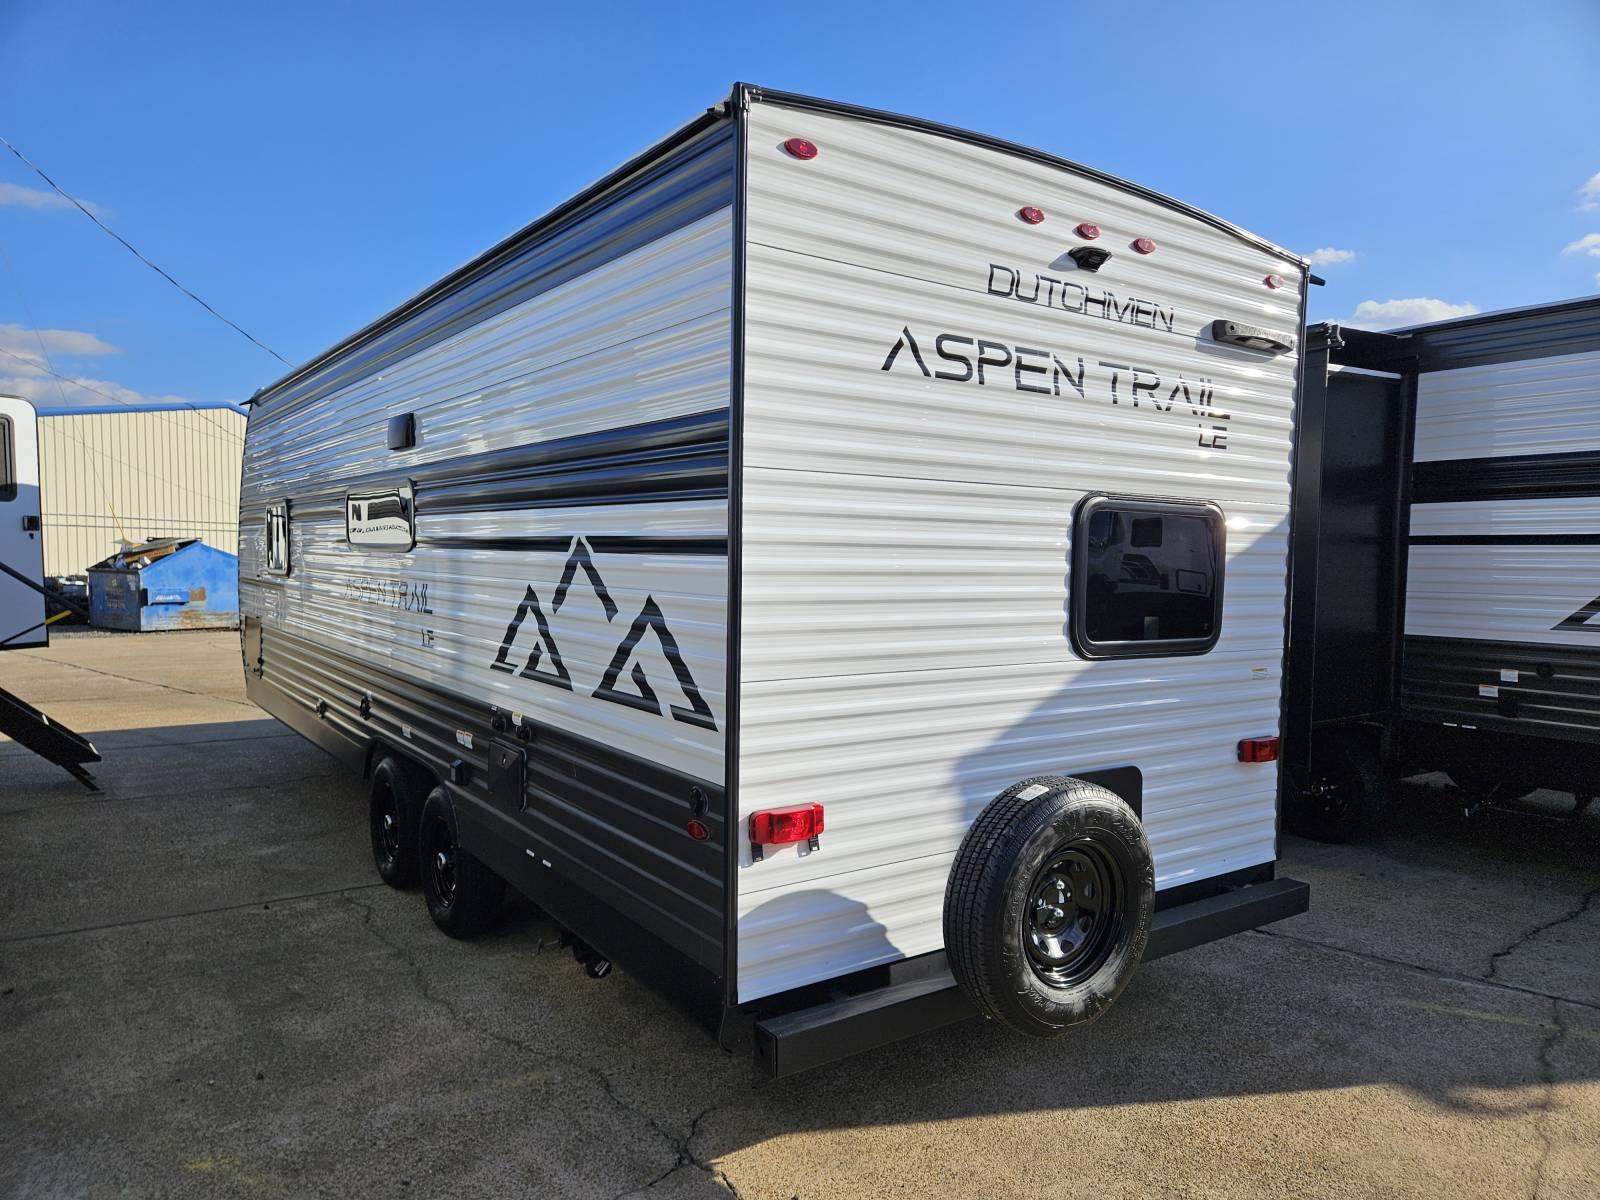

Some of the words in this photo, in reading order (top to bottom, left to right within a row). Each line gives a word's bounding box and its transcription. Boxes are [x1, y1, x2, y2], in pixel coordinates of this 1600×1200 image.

[987, 263, 1175, 332] DUTCHMEN
[881, 325, 1085, 400] ASPEN
[1098, 360, 1231, 421] TRAIL
[1198, 423, 1228, 450] LE
[389, 580, 433, 614] TRAIL
